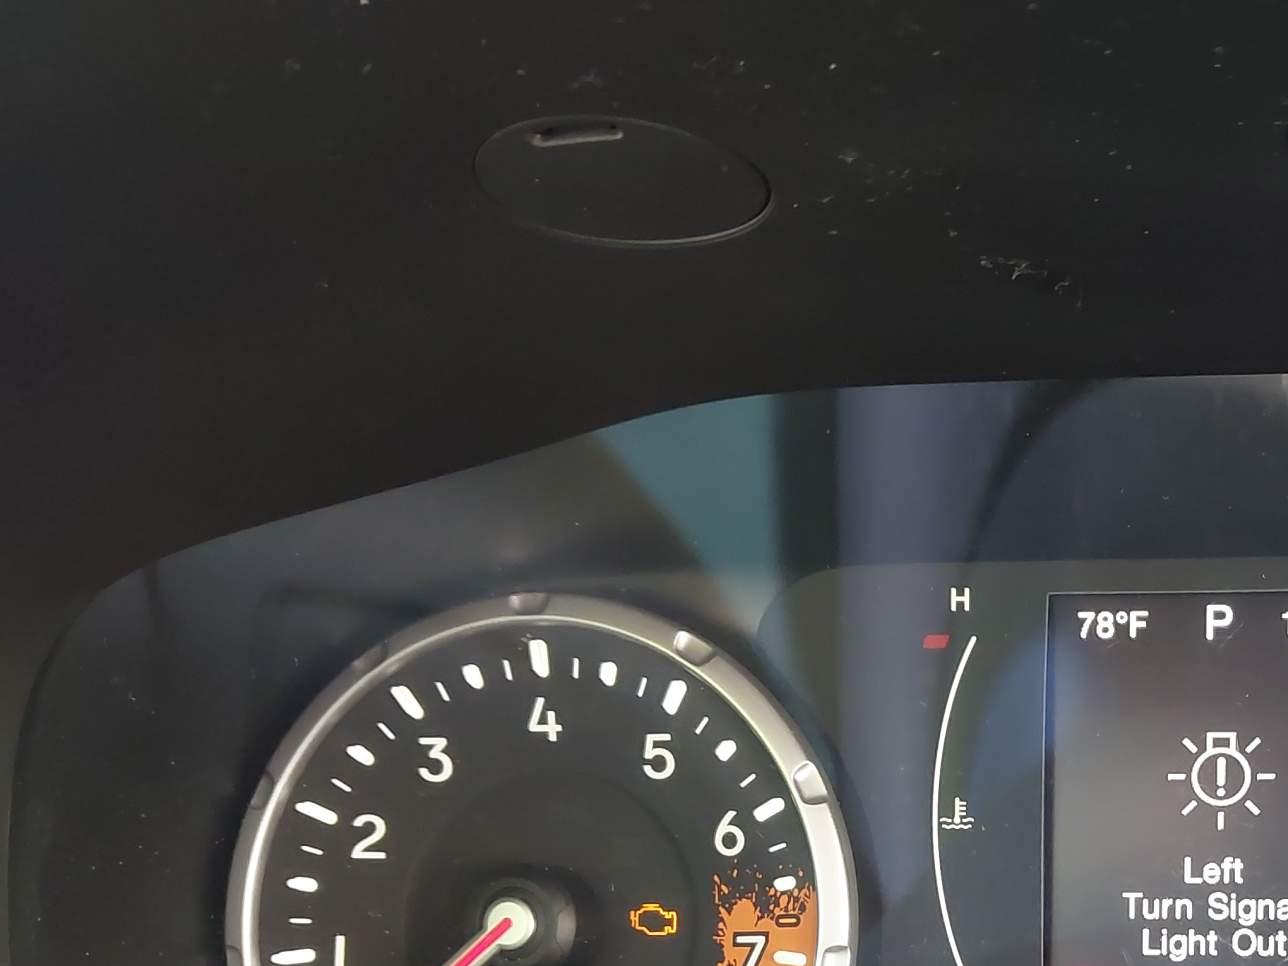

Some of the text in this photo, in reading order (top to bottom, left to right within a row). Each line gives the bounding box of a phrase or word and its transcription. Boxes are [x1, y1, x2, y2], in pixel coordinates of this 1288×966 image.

[950, 587, 970, 612] H
[1077, 610, 1149, 640] 78°F
[1205, 604, 1234, 641] P
[528, 696, 563, 742] 4
[418, 737, 453, 783] 3
[643, 733, 676, 780] 5
[350, 814, 387, 859] 2
[714, 810, 745, 857] 6
[1183, 856, 1244, 885] Left
[1122, 892, 1193, 920] Turn
[1142, 927, 1288, 962] Light Out
